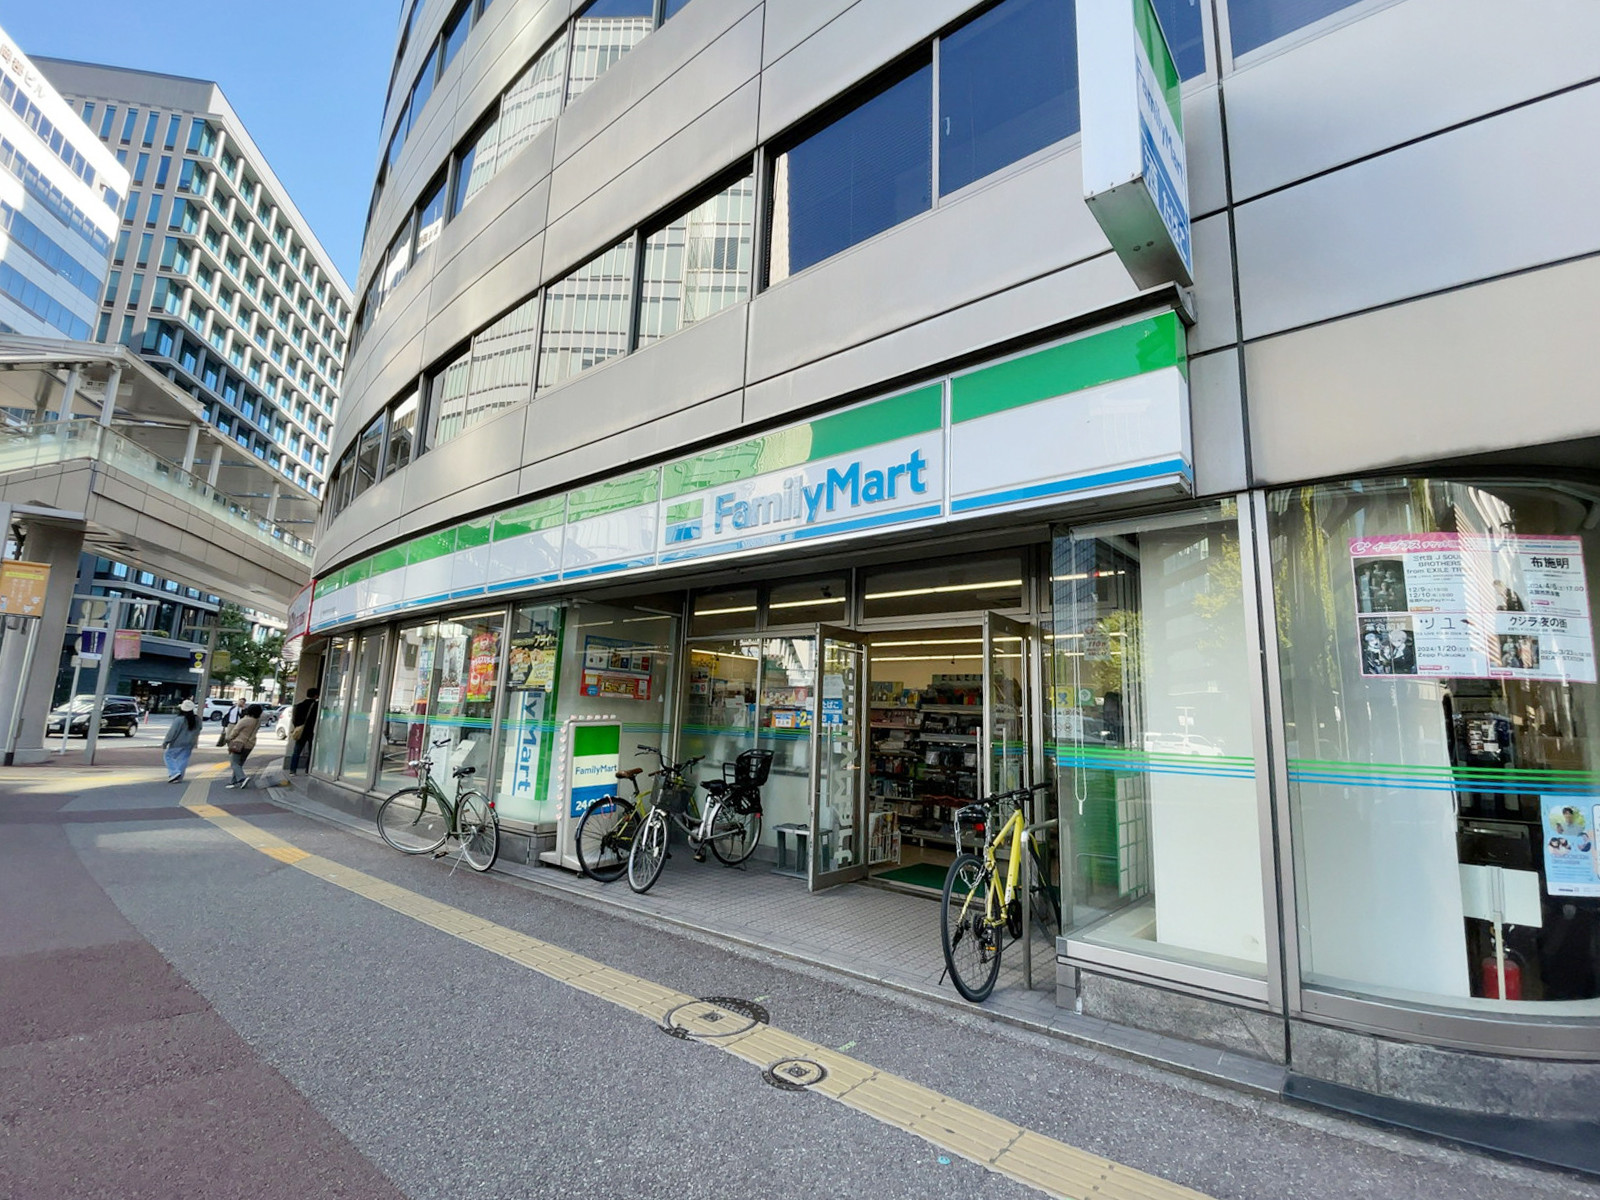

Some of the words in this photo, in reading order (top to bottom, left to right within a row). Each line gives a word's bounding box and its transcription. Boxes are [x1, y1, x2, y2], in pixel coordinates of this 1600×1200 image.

[1136, 54, 1185, 184] FamilyMart
[715, 448, 926, 534] FamilyMart
[1530, 556, 1569, 569] 布施明
[575, 764, 617, 775] FamilyMart
